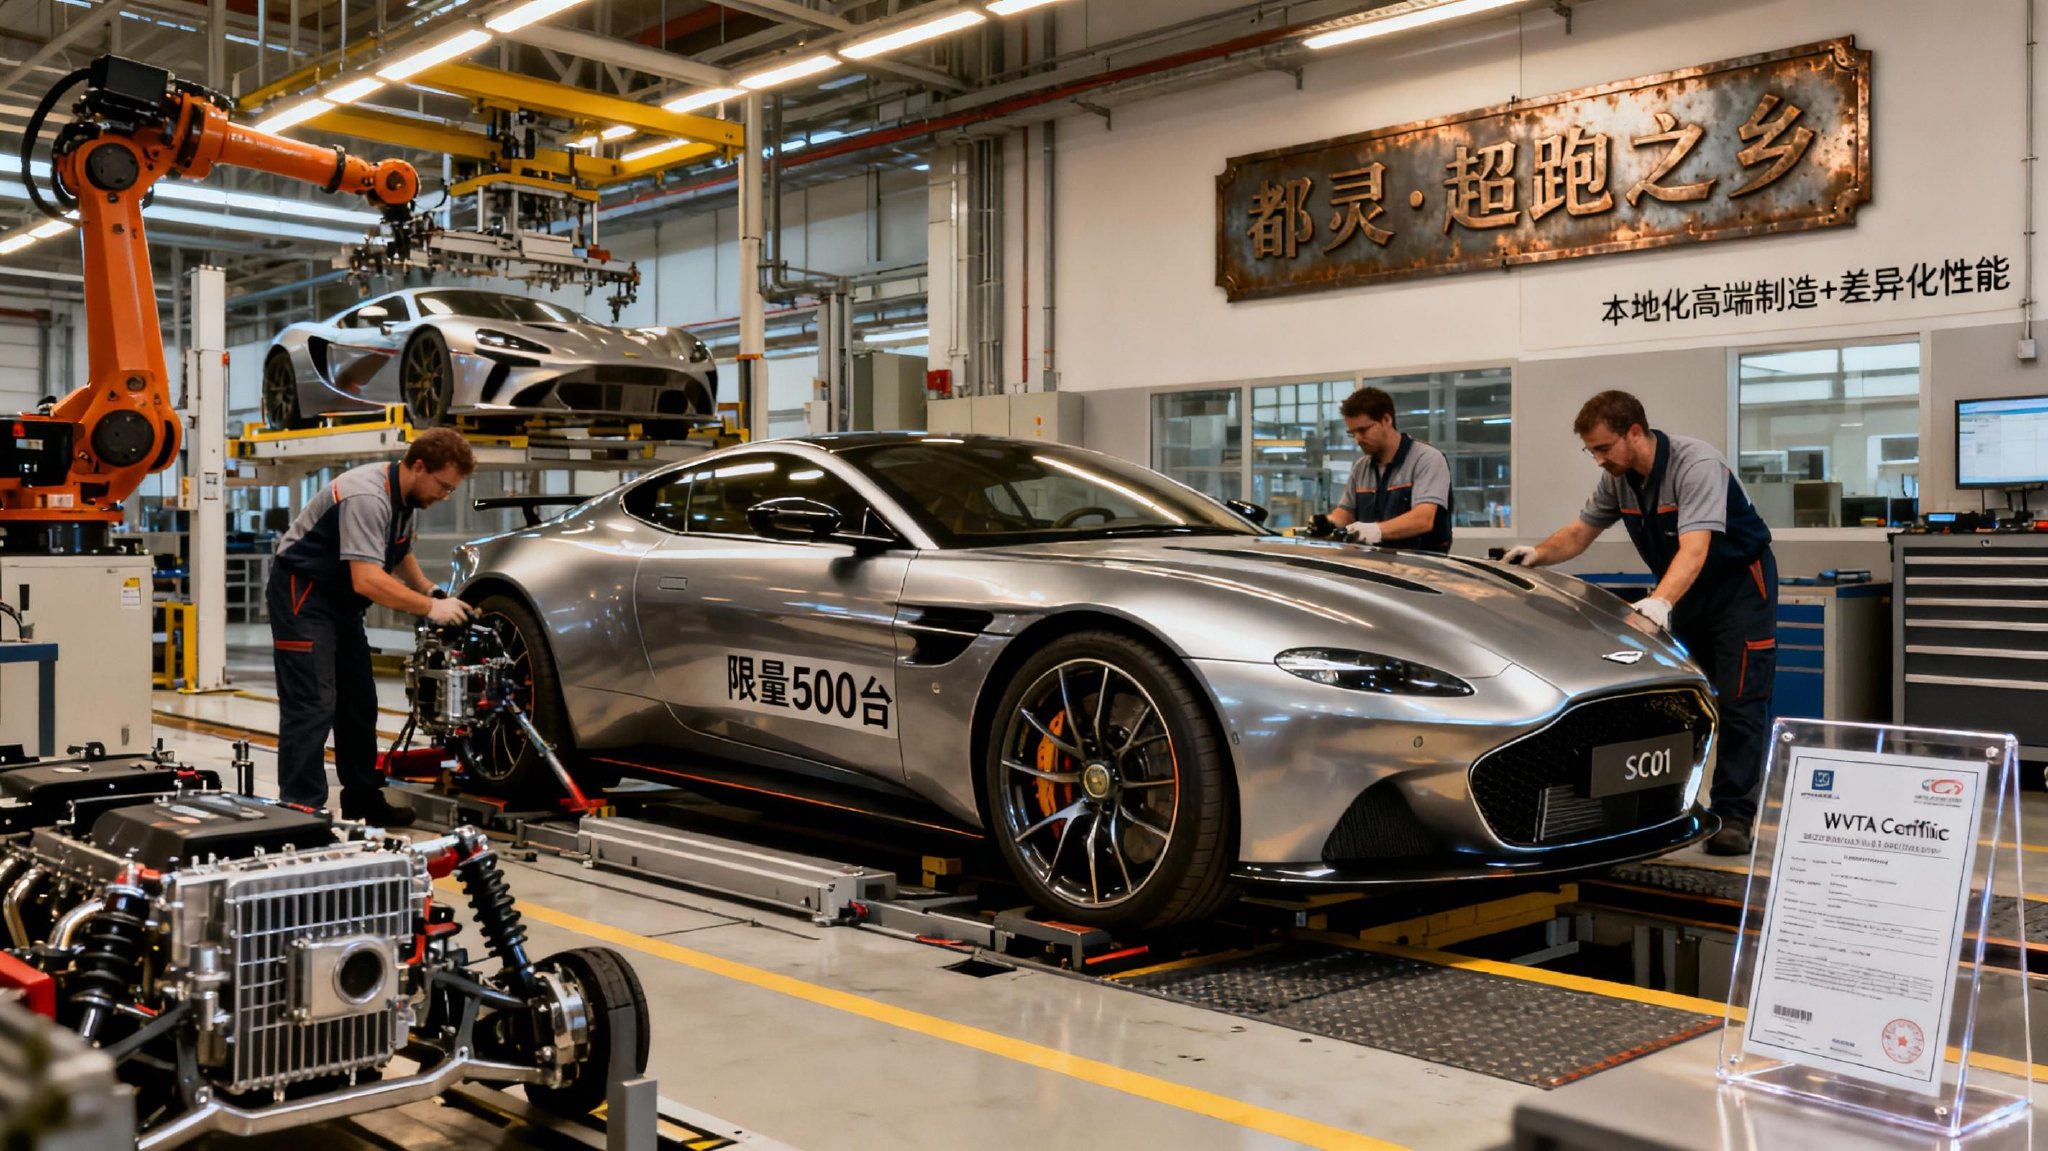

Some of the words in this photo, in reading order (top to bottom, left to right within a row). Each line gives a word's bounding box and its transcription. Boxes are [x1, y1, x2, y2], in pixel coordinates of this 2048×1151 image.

[1247, 93, 1815, 261] 都灵·超跑之乡
[1601, 255, 2011, 327] 本地化高端制造+差异化性能
[727, 654, 893, 730] 限量500台
[1624, 748, 1671, 780] SC01
[1824, 811, 1877, 834] WVTA
